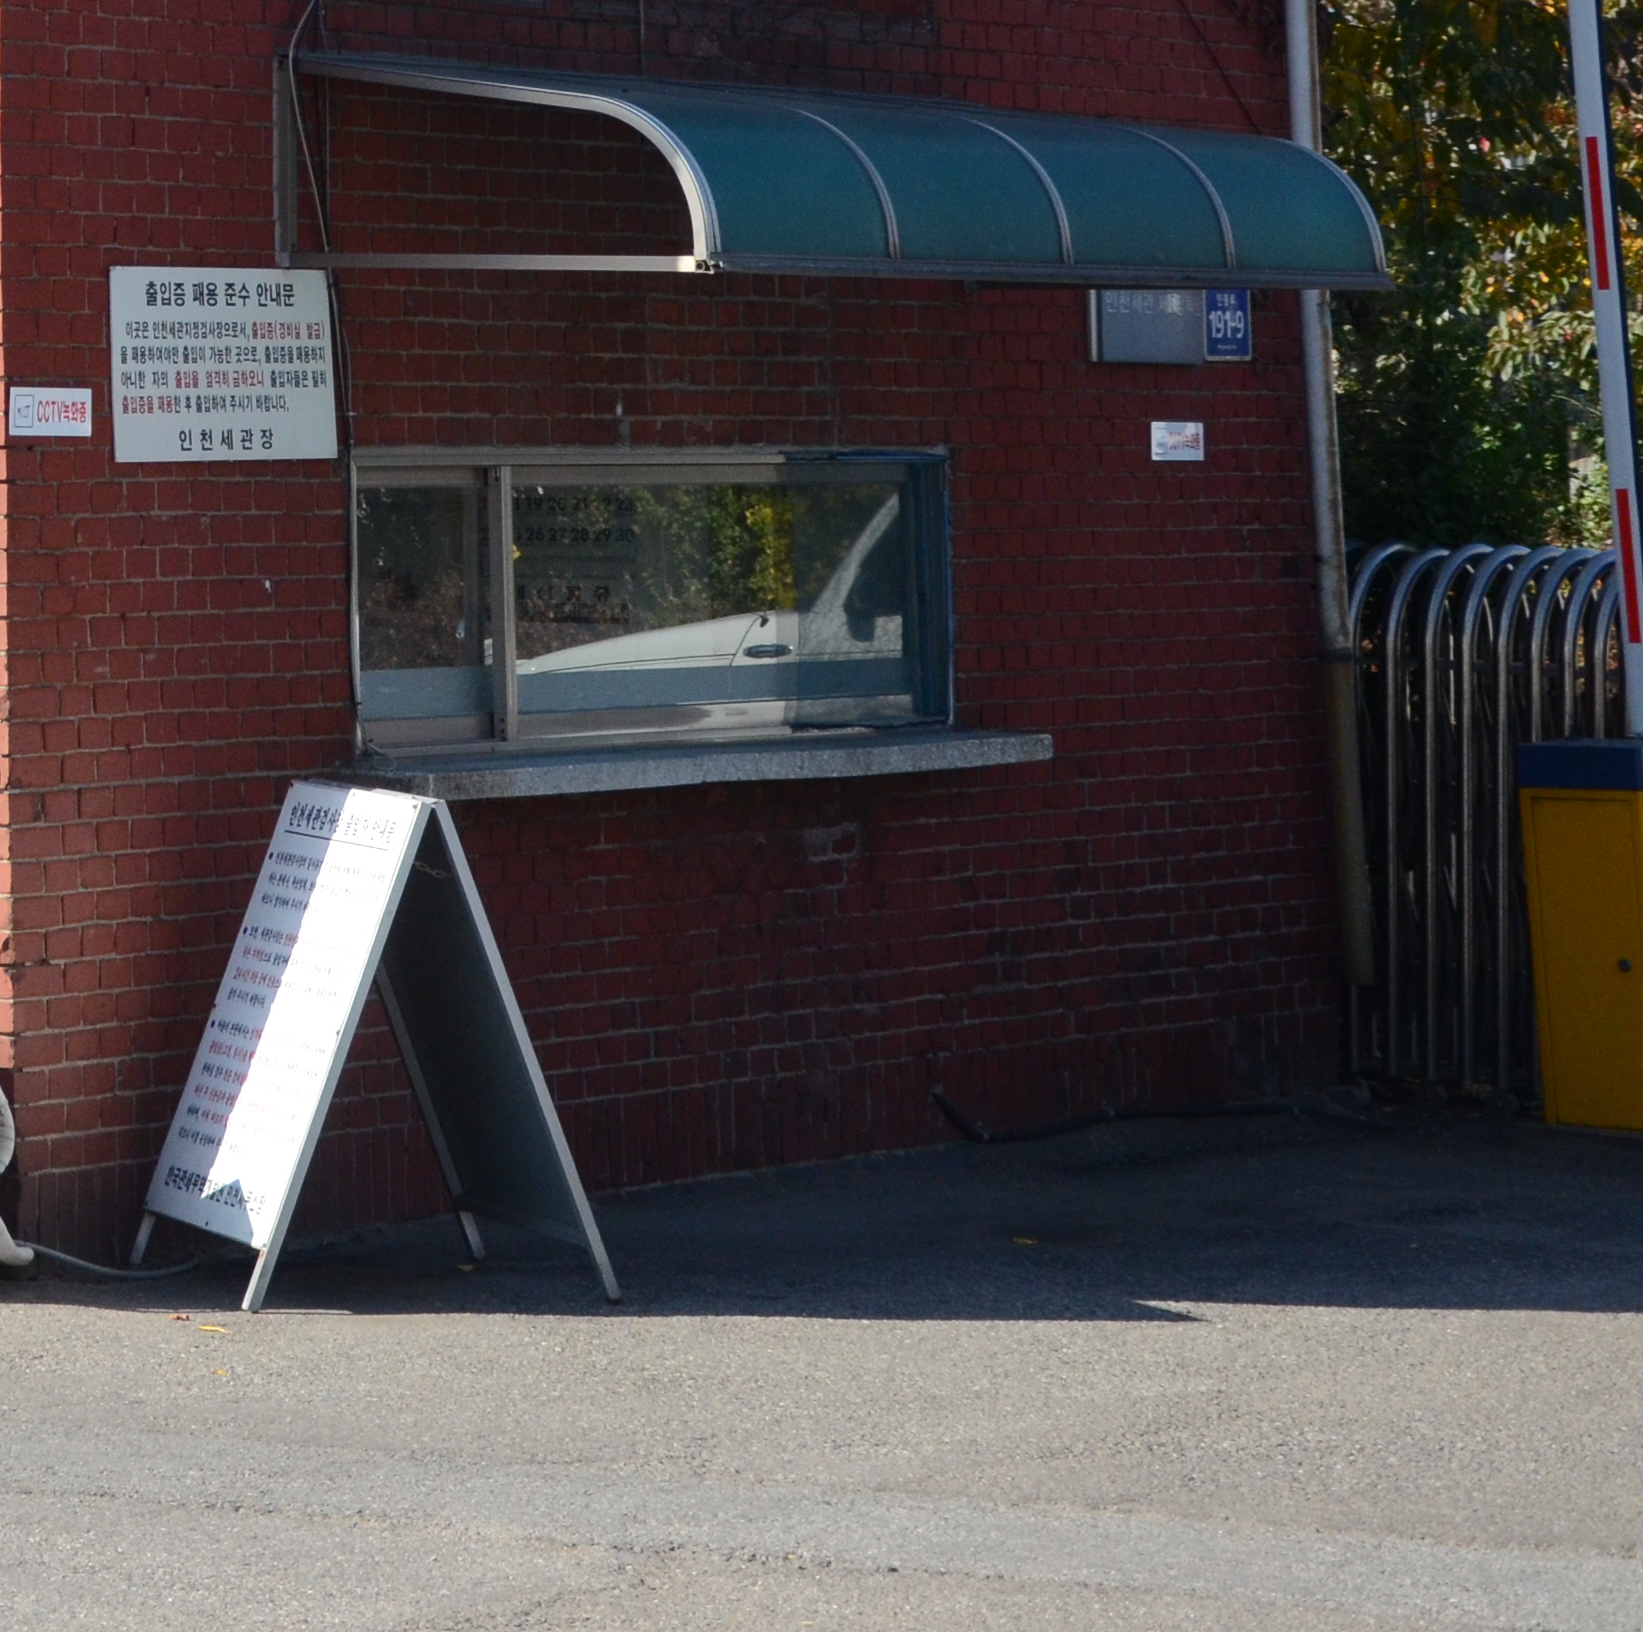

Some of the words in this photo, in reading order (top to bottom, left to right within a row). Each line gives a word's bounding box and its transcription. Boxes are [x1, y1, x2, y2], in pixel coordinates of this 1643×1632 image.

[145, 281, 185, 307] 출입증
[192, 282, 218, 307] 패용
[224, 282, 250, 307] 준수
[256, 282, 295, 307] 안내문
[126, 321, 149, 339] 이곳은
[1208, 310, 1245, 339] 191-9
[120, 347, 128, 363] 을
[131, 346, 179, 363] 패용하여야만
[182, 346, 205, 363] 출입이
[209, 346, 232, 363] 가능한
[235, 346, 261, 365] 곳으로,
[265, 346, 294, 363] 출입증을
[296, 346, 325, 363] 패용하지
[121, 371, 145, 388] 아니한
[152, 371, 168, 388] 자의
[174, 370, 199, 388] 출입을
[205, 370, 229, 387] 엄격히
[232, 370, 264, 388] 금하오니
[270, 370, 309, 388] 출입자들은
[311, 370, 327, 387] 필히
[121, 396, 154, 414] 출입증을
[157, 395, 181, 414] 패용한
[184, 395, 192, 413] 후
[195, 395, 227, 413] 출입하여
[230, 395, 253, 413] 주시기
[256, 395, 289, 413] 바랍니다.
